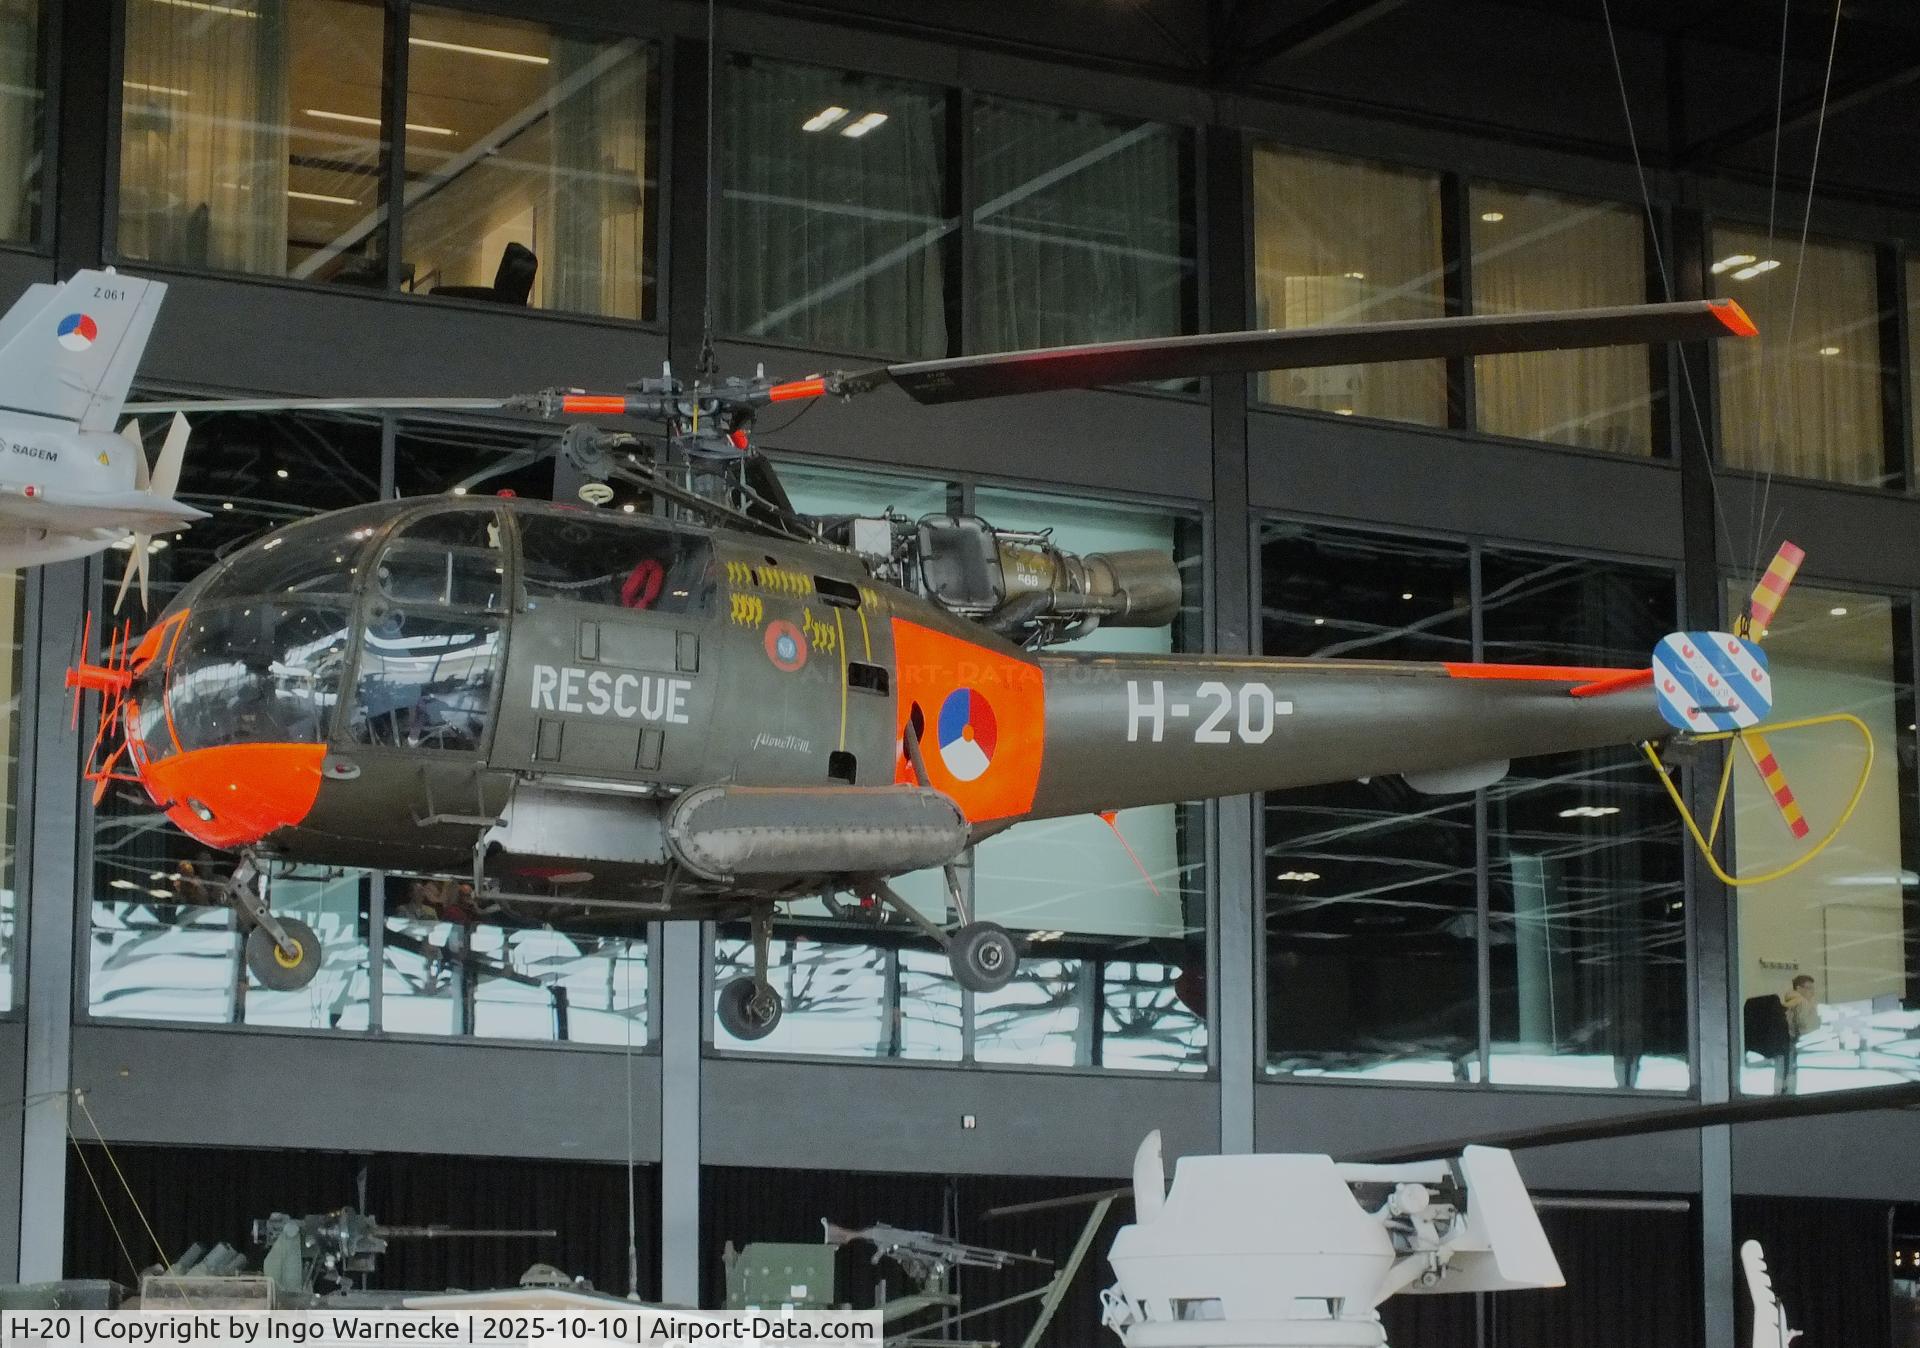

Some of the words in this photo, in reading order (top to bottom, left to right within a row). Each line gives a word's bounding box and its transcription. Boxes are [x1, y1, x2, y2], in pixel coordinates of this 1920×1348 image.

[93, 287, 101, 298] Z
[103, 289, 126, 301] 061
[12, 444, 58, 462] SAGEM
[530, 664, 692, 724] RESCUE
